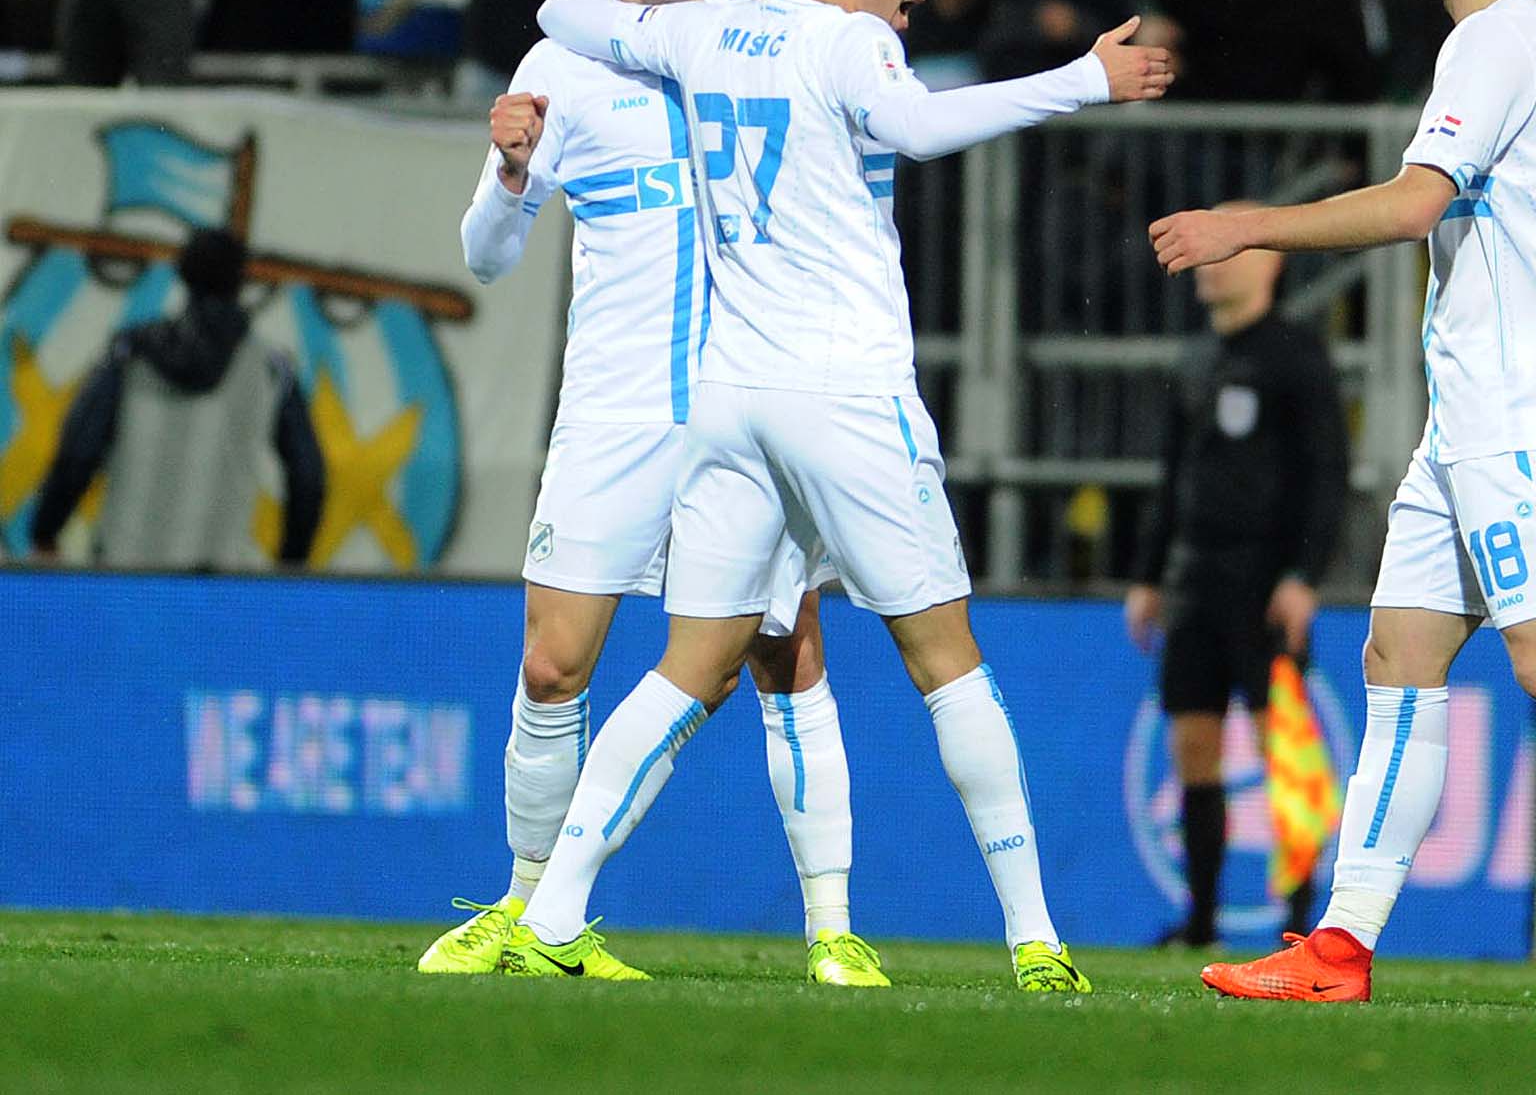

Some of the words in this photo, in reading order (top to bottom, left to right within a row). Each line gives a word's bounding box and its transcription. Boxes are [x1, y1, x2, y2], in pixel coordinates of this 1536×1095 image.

[611, 96, 649, 111] JAKO
[1469, 520, 1529, 598] 18
[1498, 593, 1525, 611] JAKO
[985, 834, 1025, 854] JAKO
